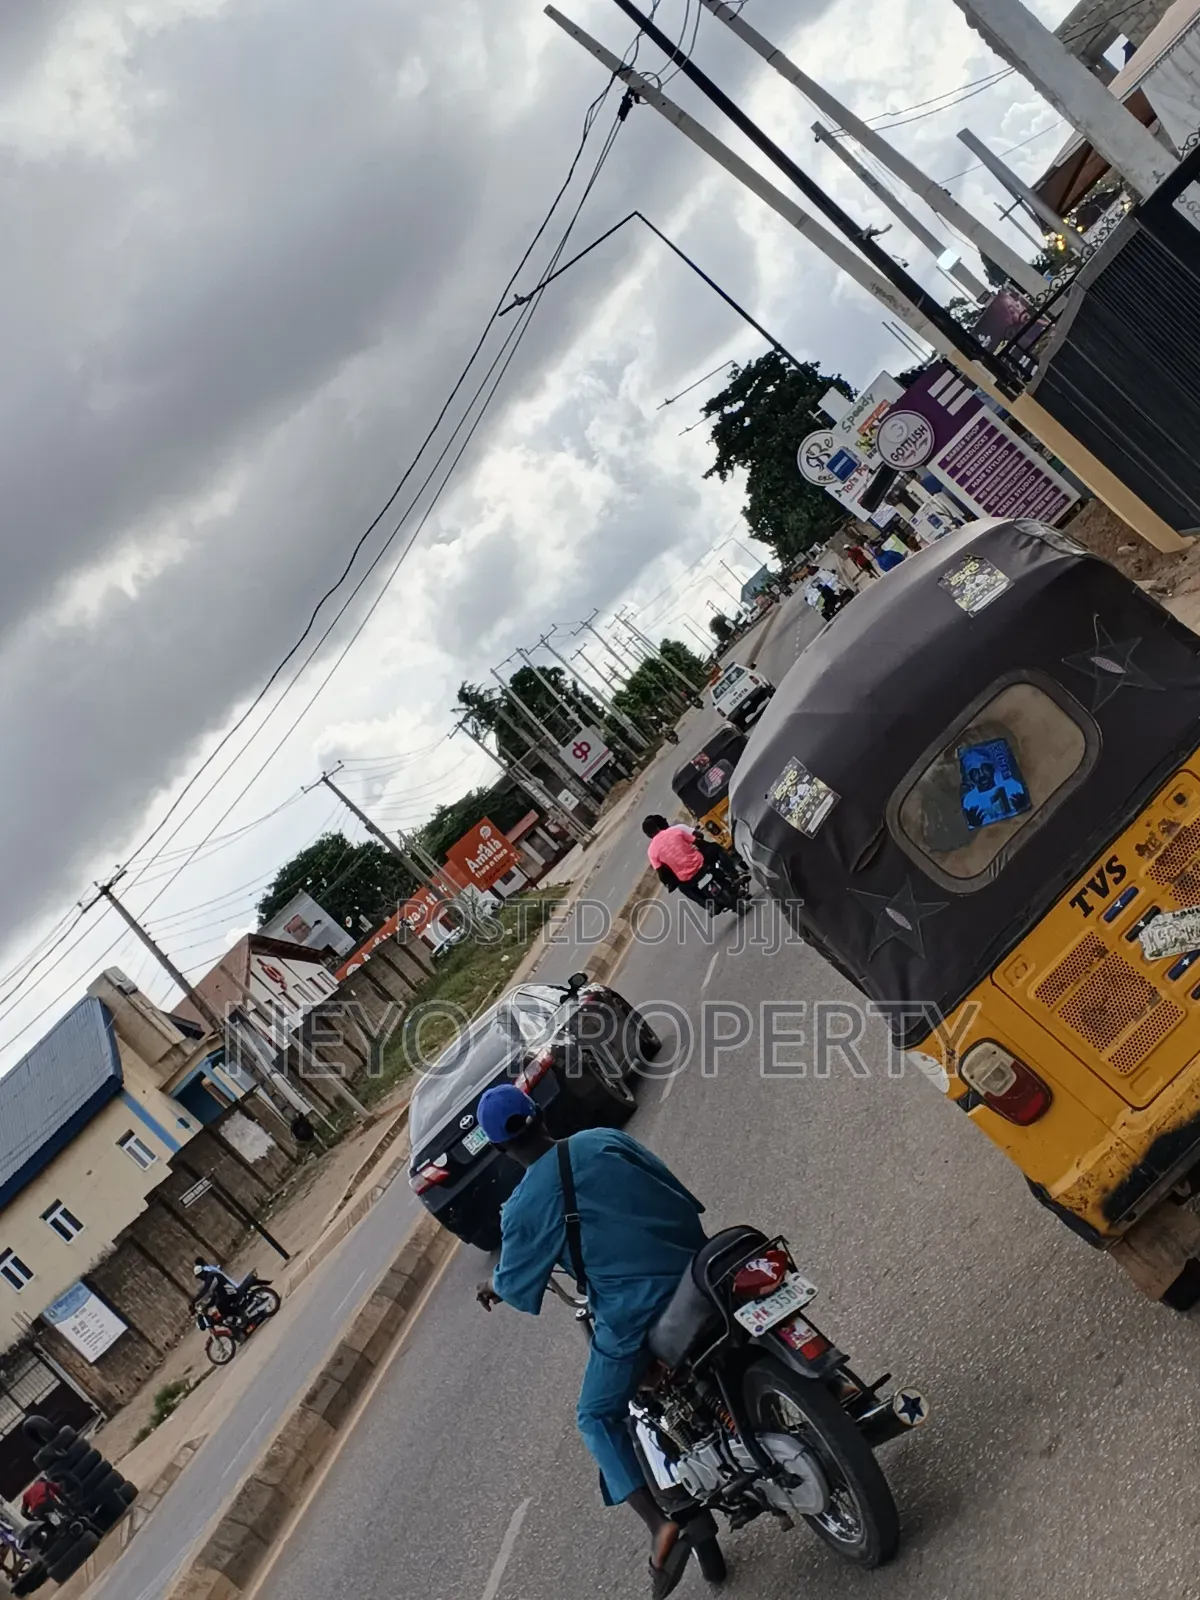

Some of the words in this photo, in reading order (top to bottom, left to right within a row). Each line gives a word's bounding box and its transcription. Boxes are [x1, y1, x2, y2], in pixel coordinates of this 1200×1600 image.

[841, 393, 876, 433] Speedy
[890, 424, 929, 463] GOTTLISH
[946, 439, 967, 462] BARBER
[965, 424, 981, 442] SHOP
[956, 434, 989, 469] DREADLOCKS
[965, 444, 998, 477] BRAIDING
[971, 472, 986, 488] HAIR
[985, 449, 1008, 473] STYLING
[988, 495, 999, 506] WIG
[997, 466, 1027, 496] INSTALLATION
[997, 496, 1014, 514] NAILS
[1013, 474, 1035, 497] STUDIO
[1069, 854, 1127, 918] TVS
